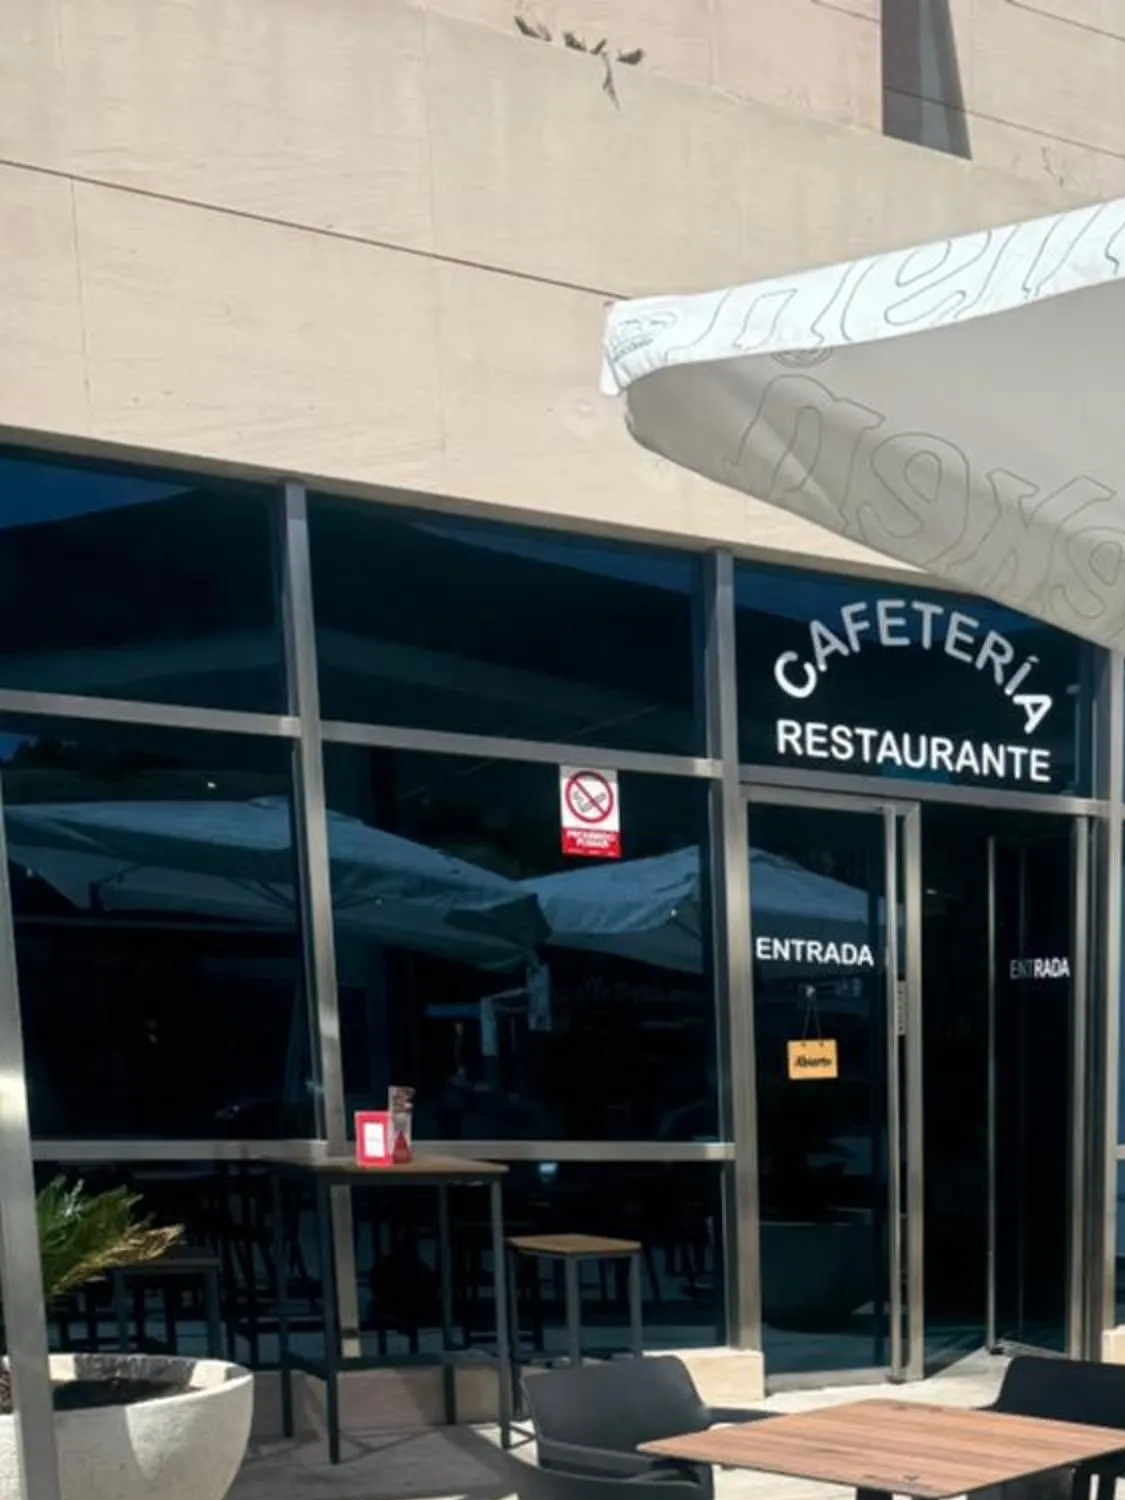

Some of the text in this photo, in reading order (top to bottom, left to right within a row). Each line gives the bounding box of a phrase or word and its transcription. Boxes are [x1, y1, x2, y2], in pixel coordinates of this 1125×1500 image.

[773, 598, 1053, 735] CAFETERÍA
[776, 718, 1052, 783] RESTAURANTE
[755, 936, 875, 967] ENTRADA
[1009, 956, 1070, 980] ENTRADA
